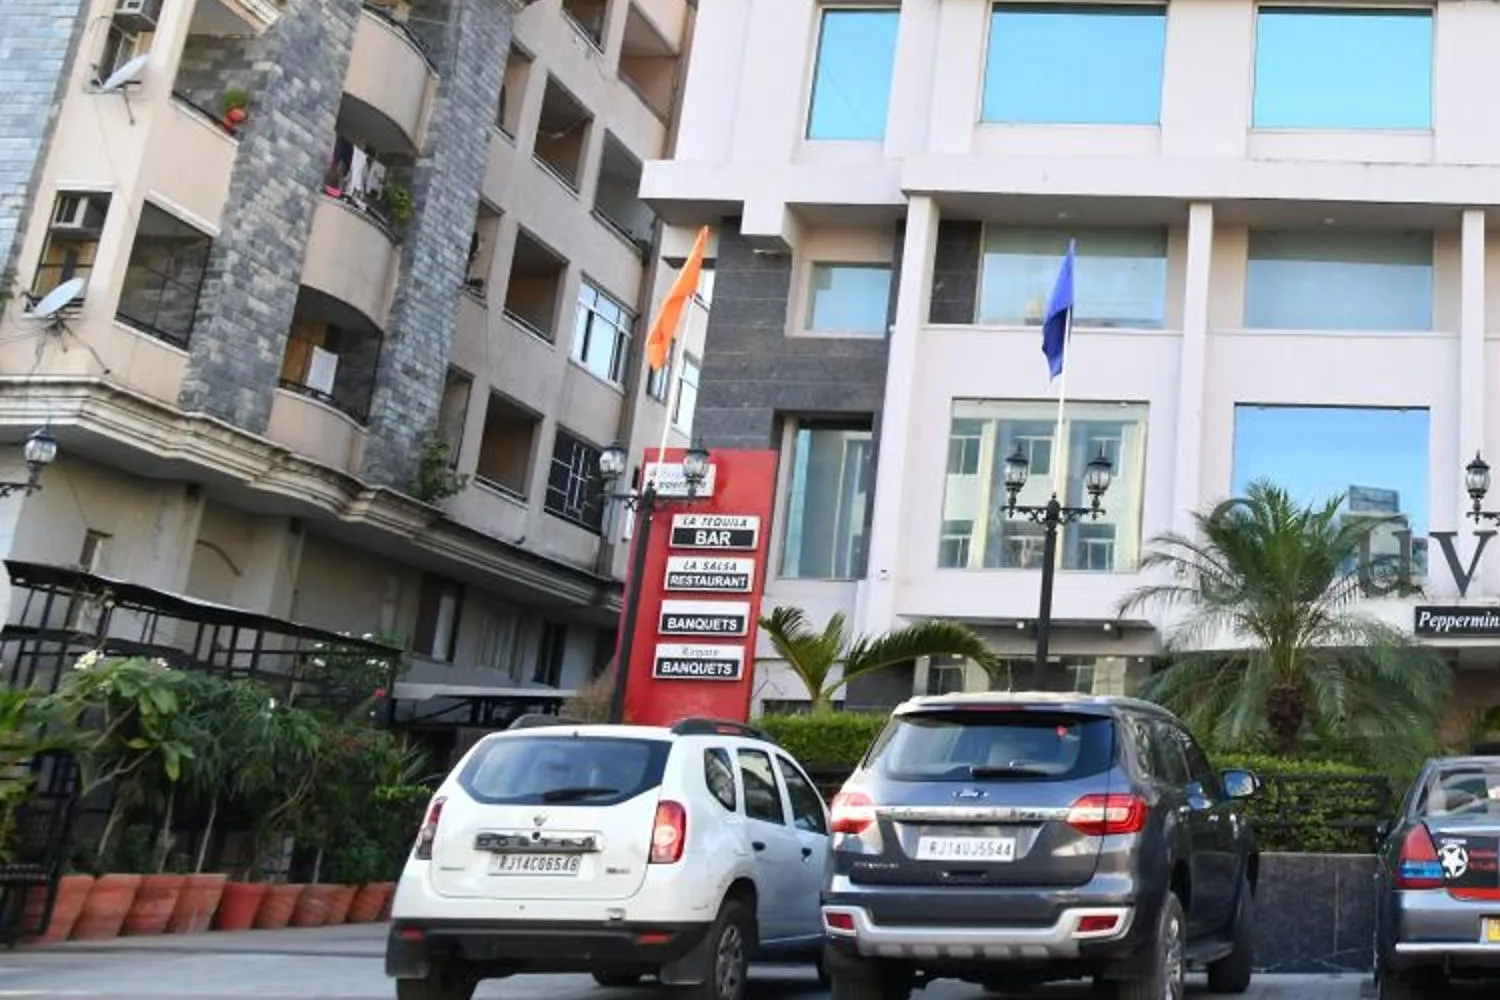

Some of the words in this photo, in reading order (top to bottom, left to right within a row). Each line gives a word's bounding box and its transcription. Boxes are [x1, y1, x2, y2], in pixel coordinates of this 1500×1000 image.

[701, 517, 748, 528] TEQUILA
[694, 530, 731, 546] BAR
[683, 560, 698, 571] LA
[703, 560, 737, 571] SALSA
[668, 574, 747, 588] RESTAURANT
[667, 617, 738, 631] BANQUETS
[661, 660, 733, 675] BANQUETS
